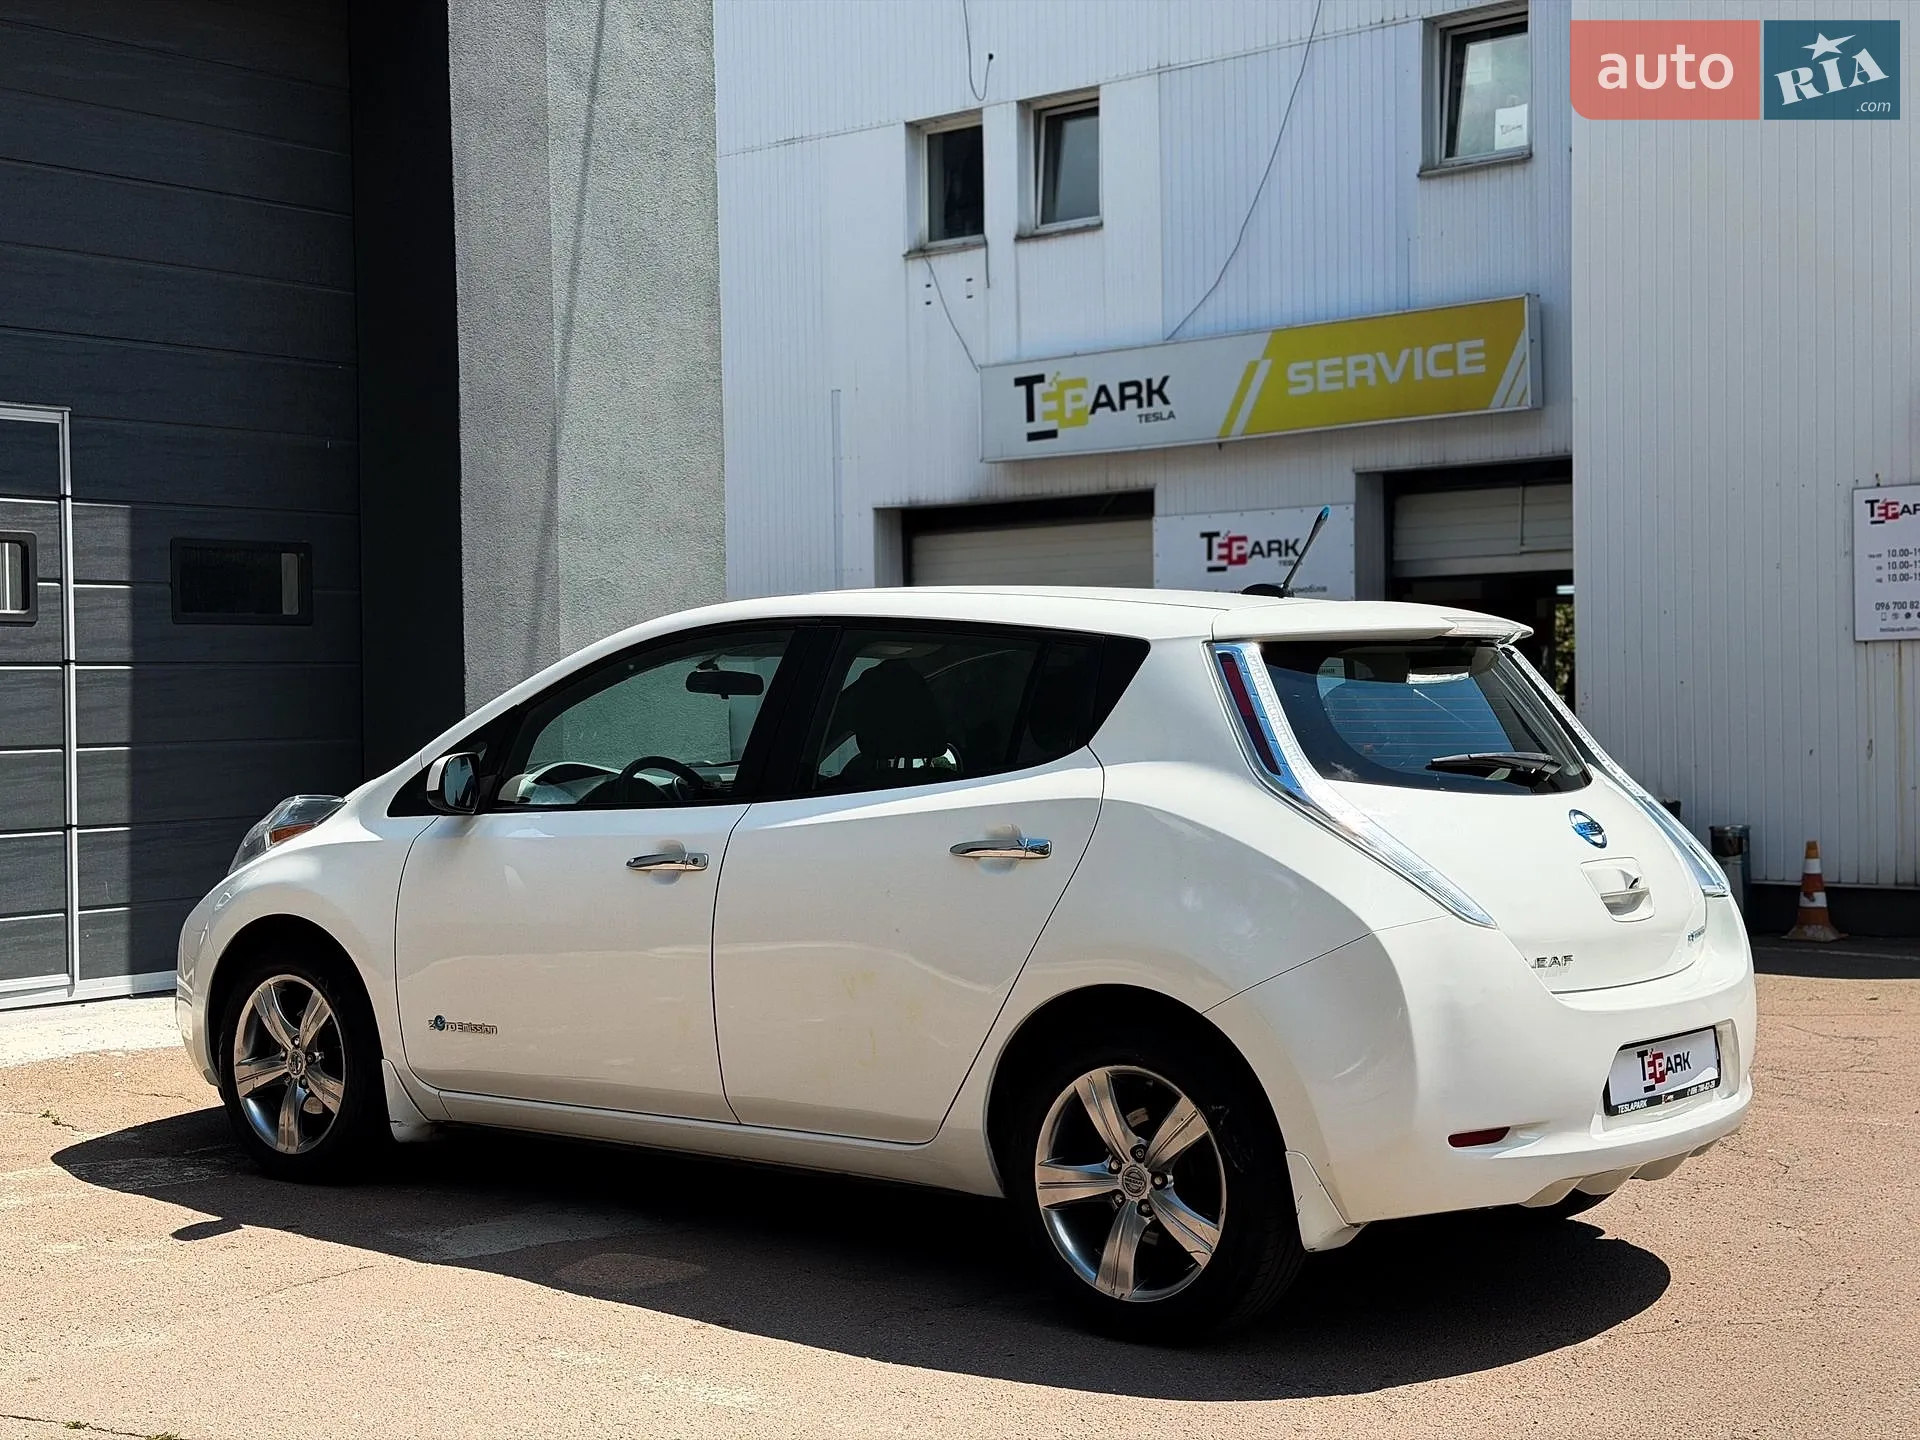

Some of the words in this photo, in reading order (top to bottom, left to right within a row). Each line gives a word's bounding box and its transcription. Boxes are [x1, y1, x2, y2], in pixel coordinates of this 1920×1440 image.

[1287, 339, 1486, 396] SERVICE
[1138, 410, 1176, 424] TESLA
[1875, 602, 1890, 611] 096
[1892, 601, 1907, 610] 700
[1909, 600, 1920, 609] 82
[1618, 1099, 1648, 1114] TESLAPARK
